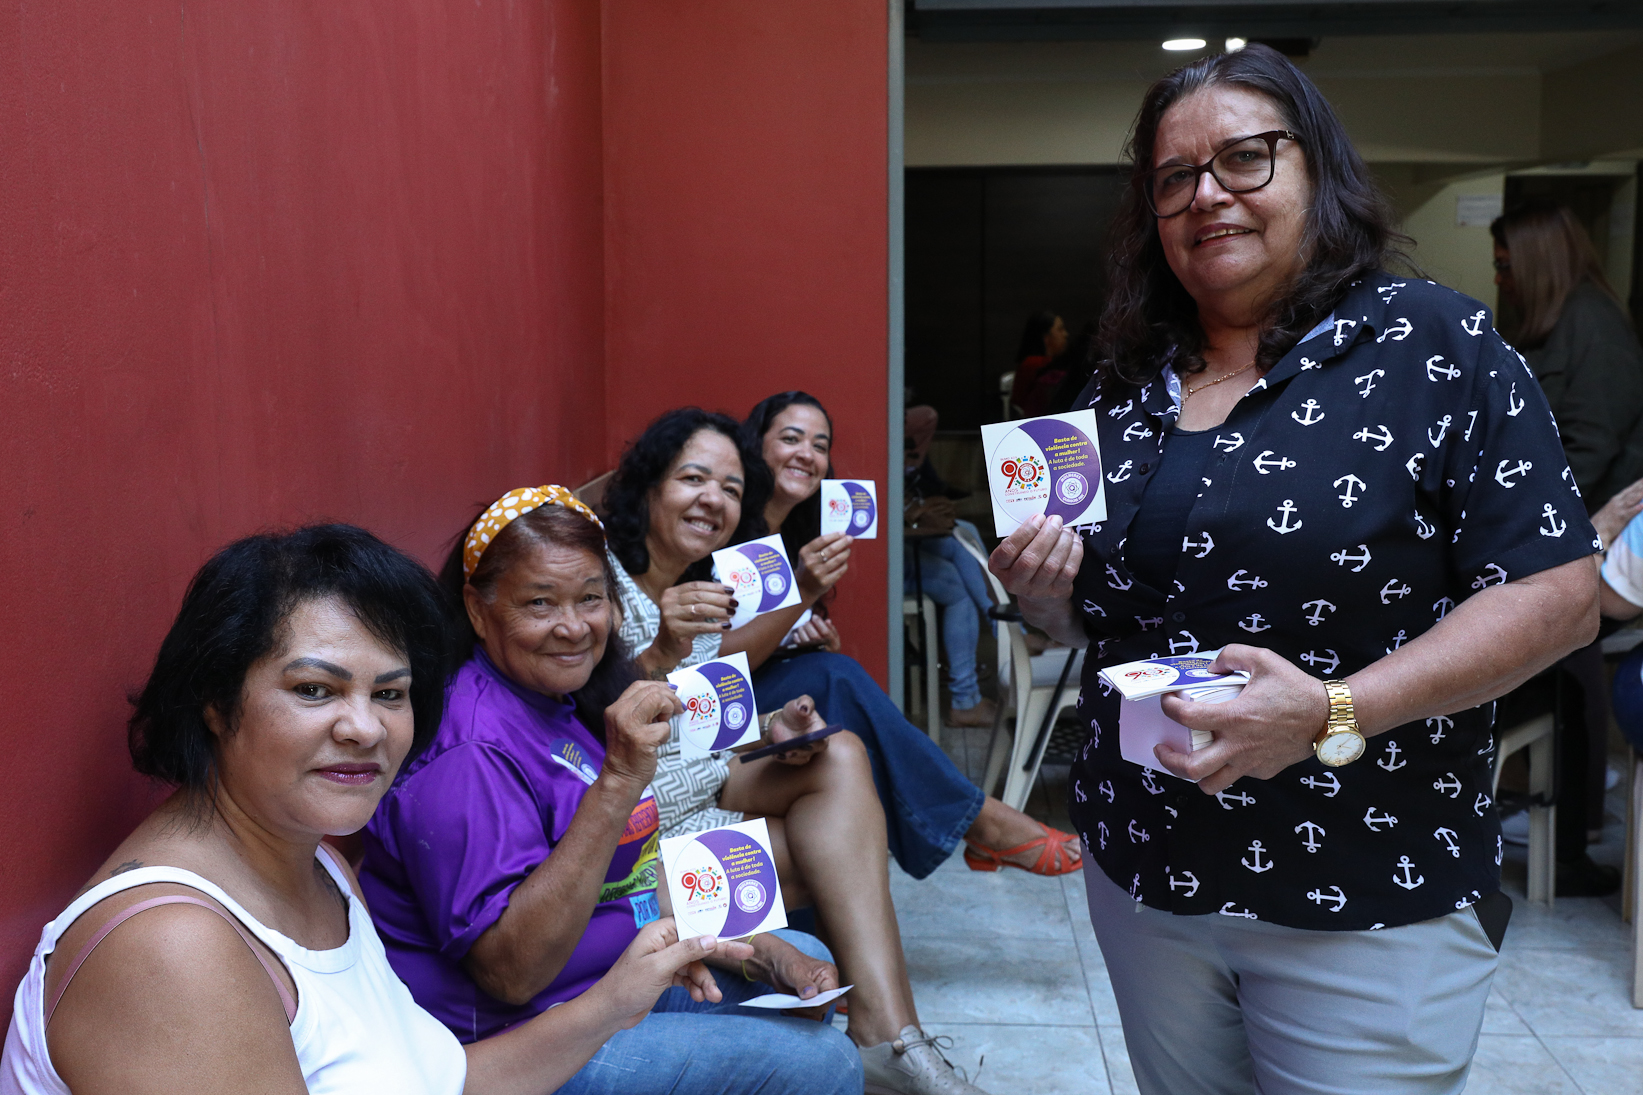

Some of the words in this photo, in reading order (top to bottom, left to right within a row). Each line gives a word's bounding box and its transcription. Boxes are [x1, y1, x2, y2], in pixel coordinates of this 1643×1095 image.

[1001, 460, 1037, 489] 90
[1061, 474, 1081, 482] MULHERES
[687, 698, 711, 720] 90
[682, 872, 716, 901] 90
